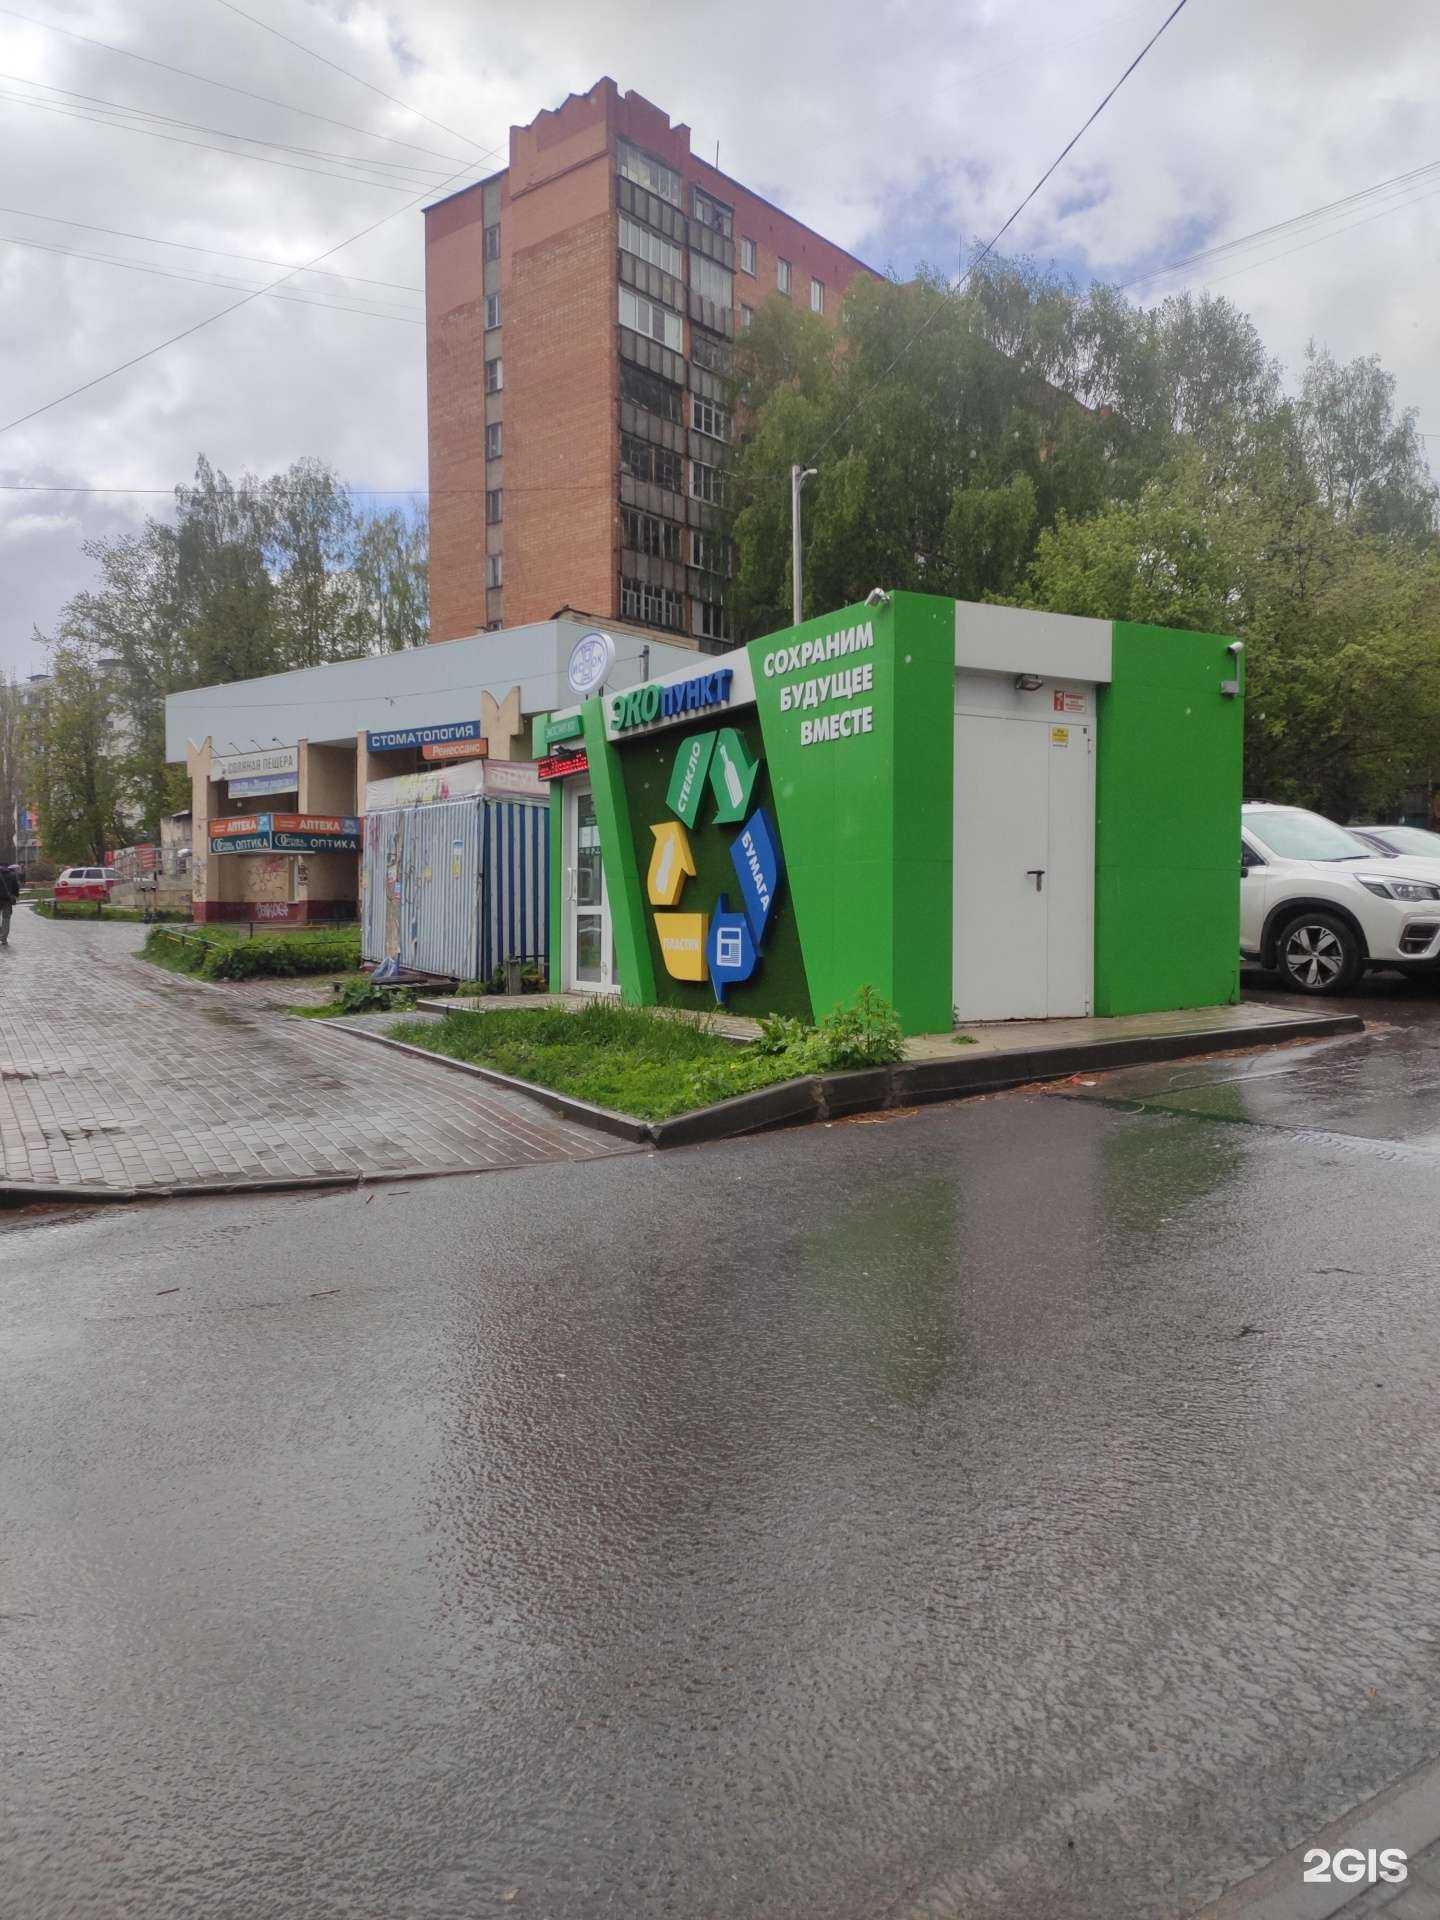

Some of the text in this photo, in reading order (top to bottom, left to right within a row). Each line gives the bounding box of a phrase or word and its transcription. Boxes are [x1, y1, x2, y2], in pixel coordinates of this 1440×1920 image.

[763, 620, 874, 678] СОХРАНИМ
[780, 663, 873, 712] БУДУЩЕЕ
[371, 725, 475, 747] СТОМАТОЛОГИЯ
[800, 706, 873, 746] ВМЕСТЕ
[432, 743, 481, 757] Ренессанс
[676, 741, 701, 814] СТЕКЛО
[227, 820, 257, 833] АПТЕКА
[299, 819, 340, 831] АПТЕКА
[235, 838, 269, 850] ОПТИКА
[310, 838, 357, 849] ОПТИКА
[741, 830, 770, 912] БУМАГА
